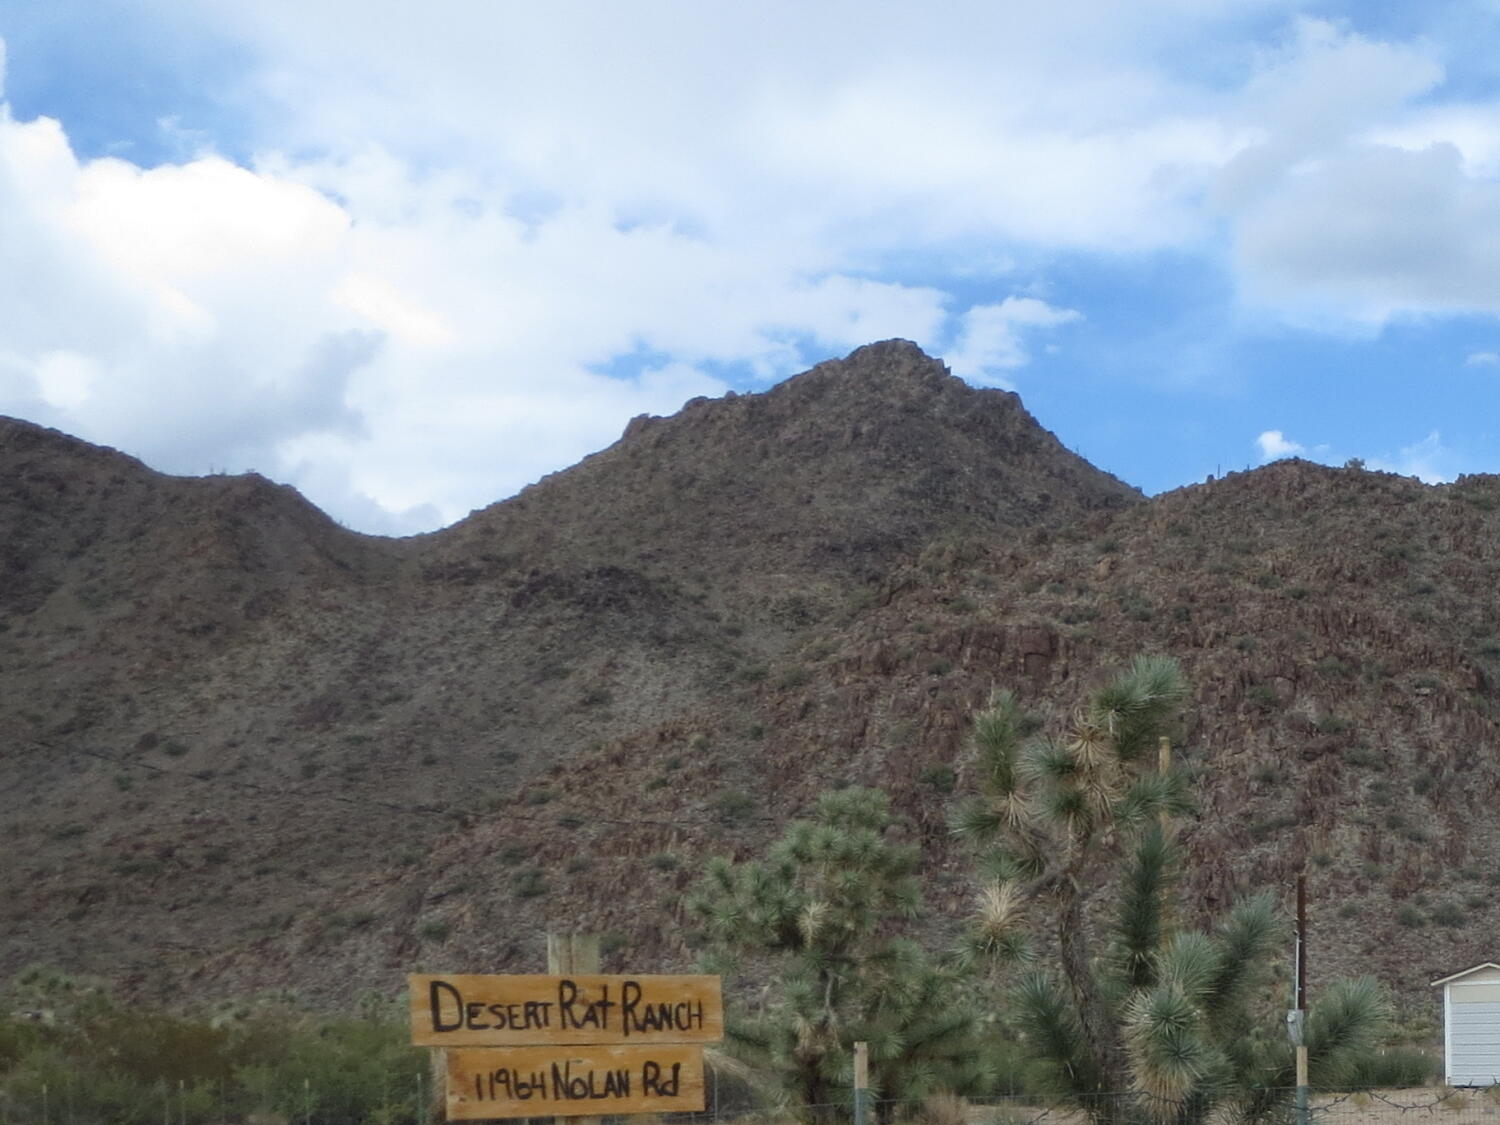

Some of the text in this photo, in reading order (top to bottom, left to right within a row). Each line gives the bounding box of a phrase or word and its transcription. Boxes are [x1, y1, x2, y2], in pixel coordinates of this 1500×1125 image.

[429, 980, 554, 1033] DESERT
[622, 980, 703, 1037] RANCH
[475, 1060, 681, 1101] 11964 NOLAN Rd
